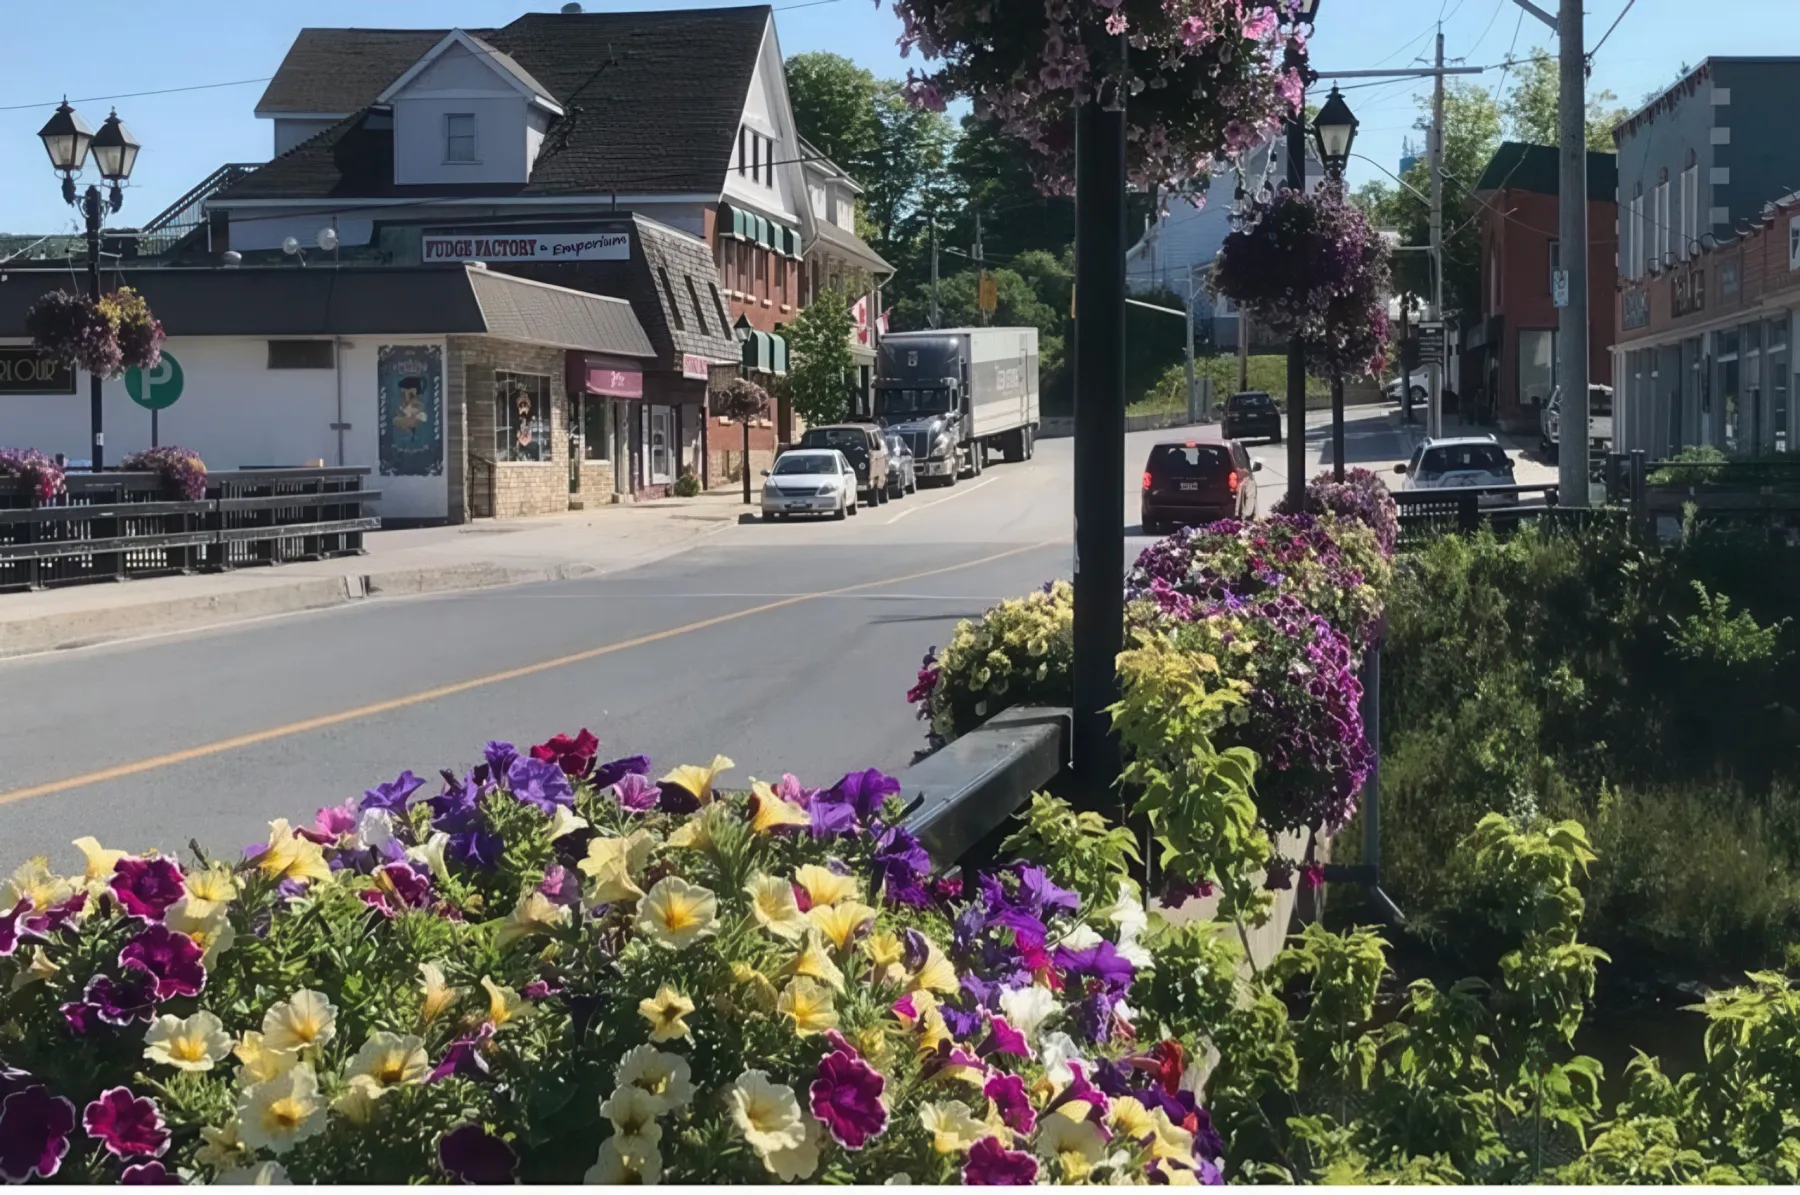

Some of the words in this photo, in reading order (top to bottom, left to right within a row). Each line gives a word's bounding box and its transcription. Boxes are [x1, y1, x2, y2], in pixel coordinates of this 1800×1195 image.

[425, 239, 473, 258] FUDGE
[474, 239, 537, 257] FACTORY
[141, 358, 173, 400] P
